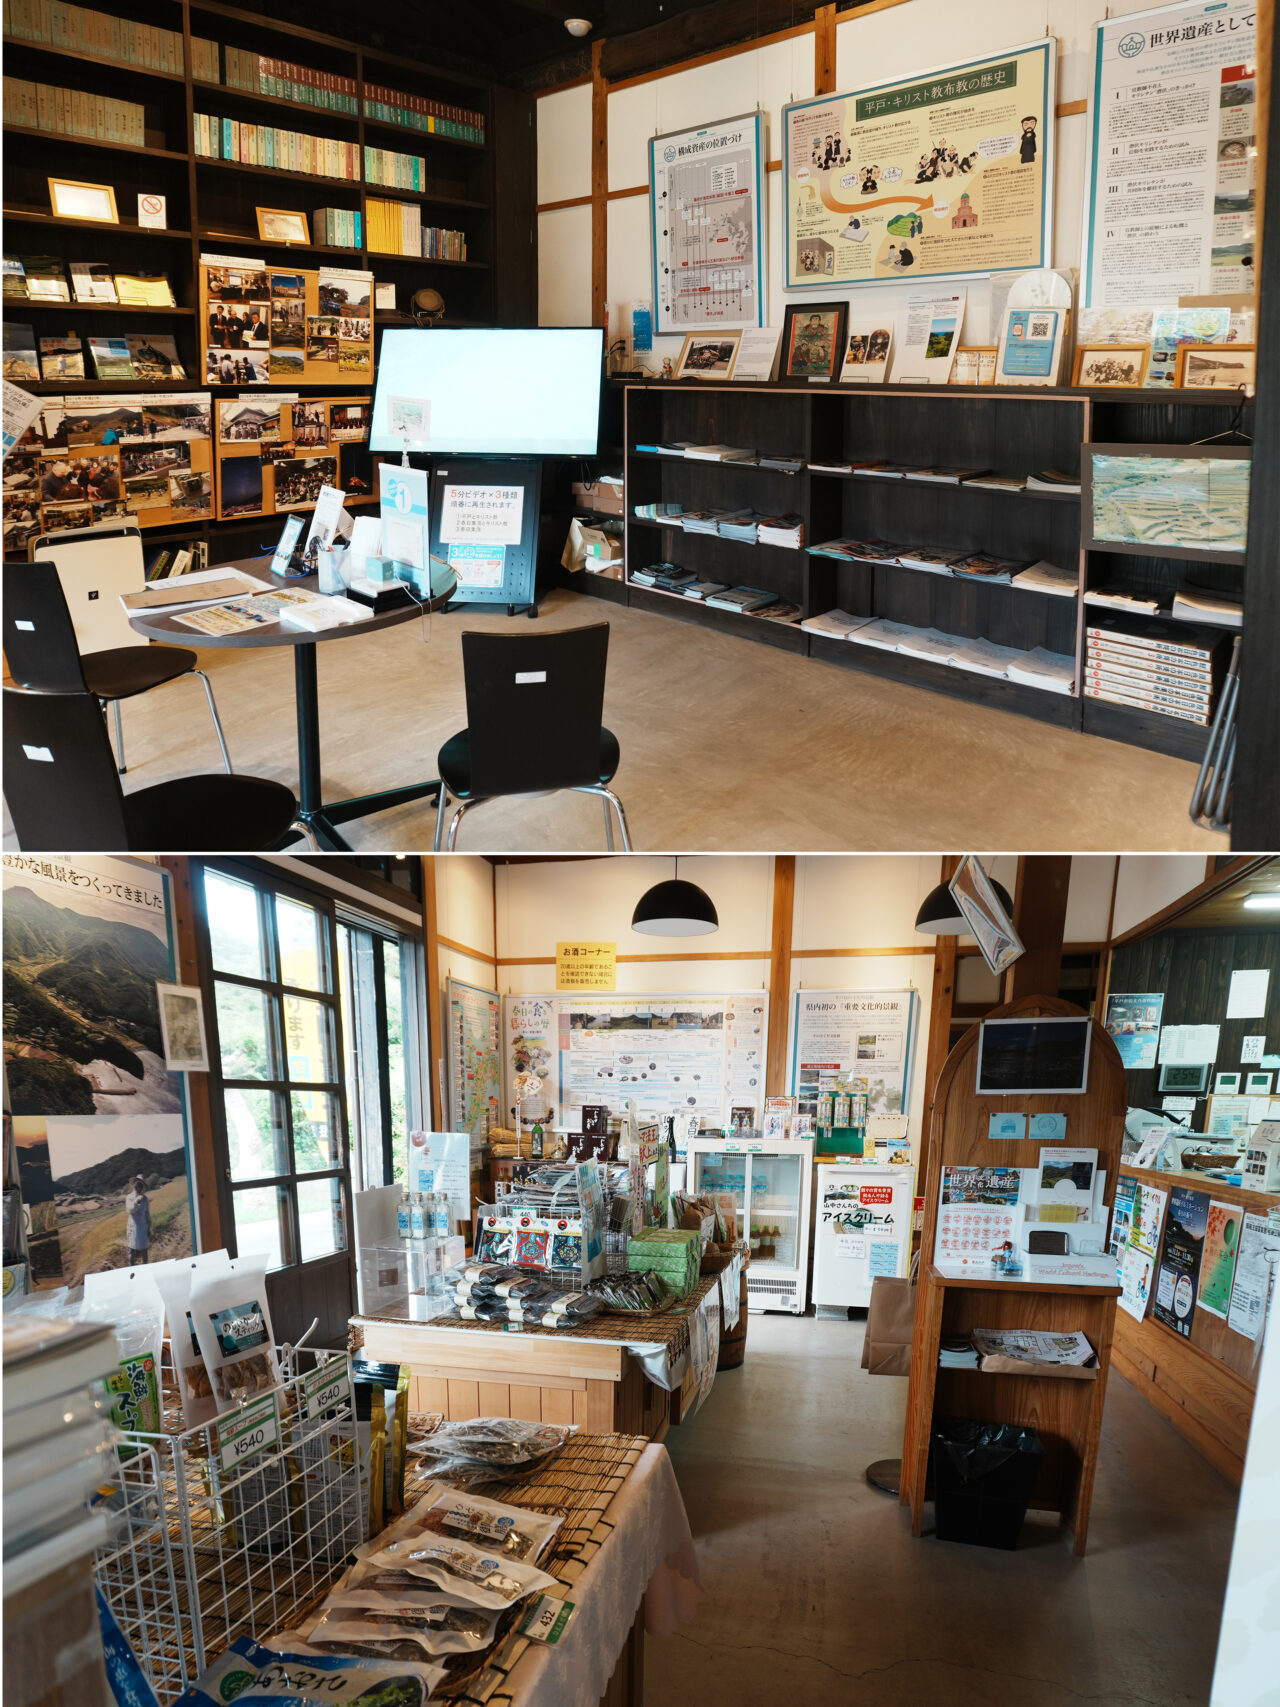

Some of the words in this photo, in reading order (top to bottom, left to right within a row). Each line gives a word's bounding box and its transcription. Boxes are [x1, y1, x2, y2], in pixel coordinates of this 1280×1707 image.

[1150, 13, 1257, 48] 世界遺産として
[864, 70, 1007, 114] 平戸・キリスト教布教の歴史
[678, 132, 742, 156] 構成資産の位置づけ
[450, 489, 518, 499] 5分ビデオ×3種類
[563, 947, 611, 956] お酒コーナー
[822, 1212, 895, 1224] アイスクリーム
[316, 1384, 340, 1408] ¥540
[233, 1429, 264, 1457] ¥540
[539, 1609, 556, 1628] 432
